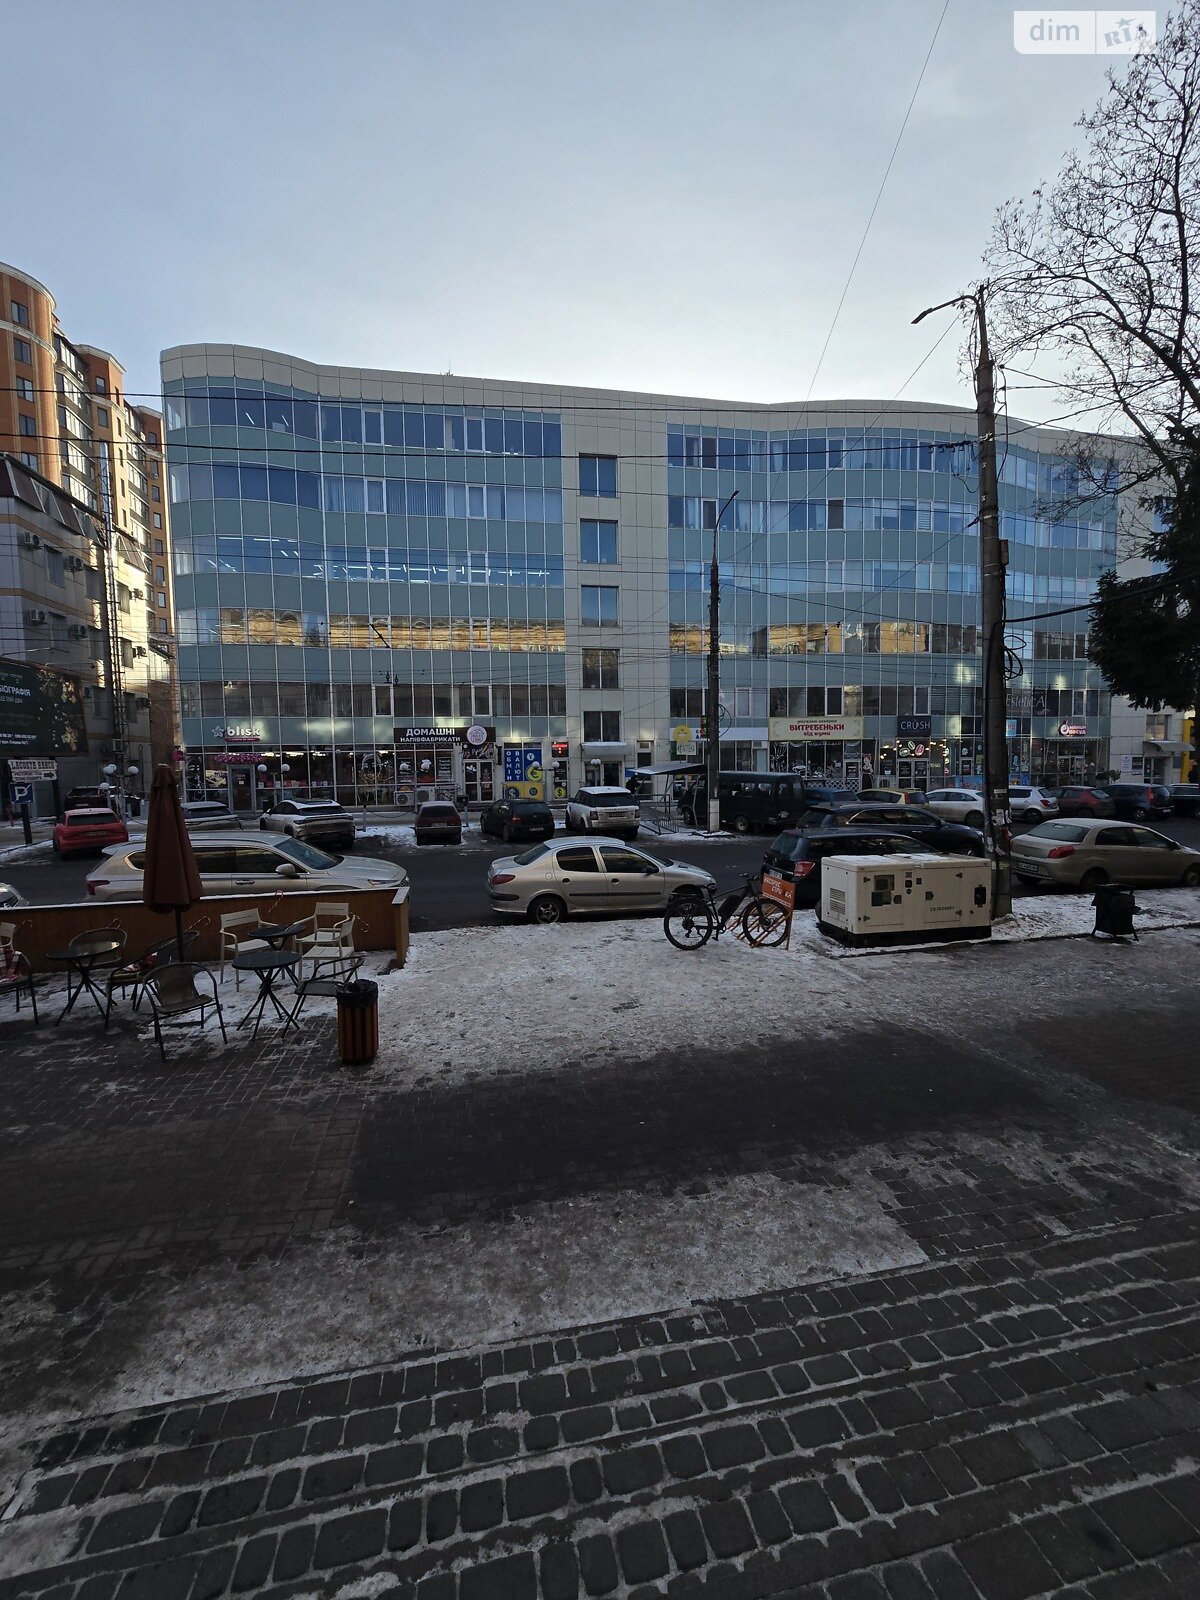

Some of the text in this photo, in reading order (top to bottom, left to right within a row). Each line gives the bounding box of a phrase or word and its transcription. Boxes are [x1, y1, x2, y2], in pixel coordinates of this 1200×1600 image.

[789, 723, 845, 731] ВИТРЕБЕНЬКИ
[900, 720, 931, 730] CRUSH
[226, 726, 261, 736] blisk
[405, 728, 455, 737] ДОМАШНІ
